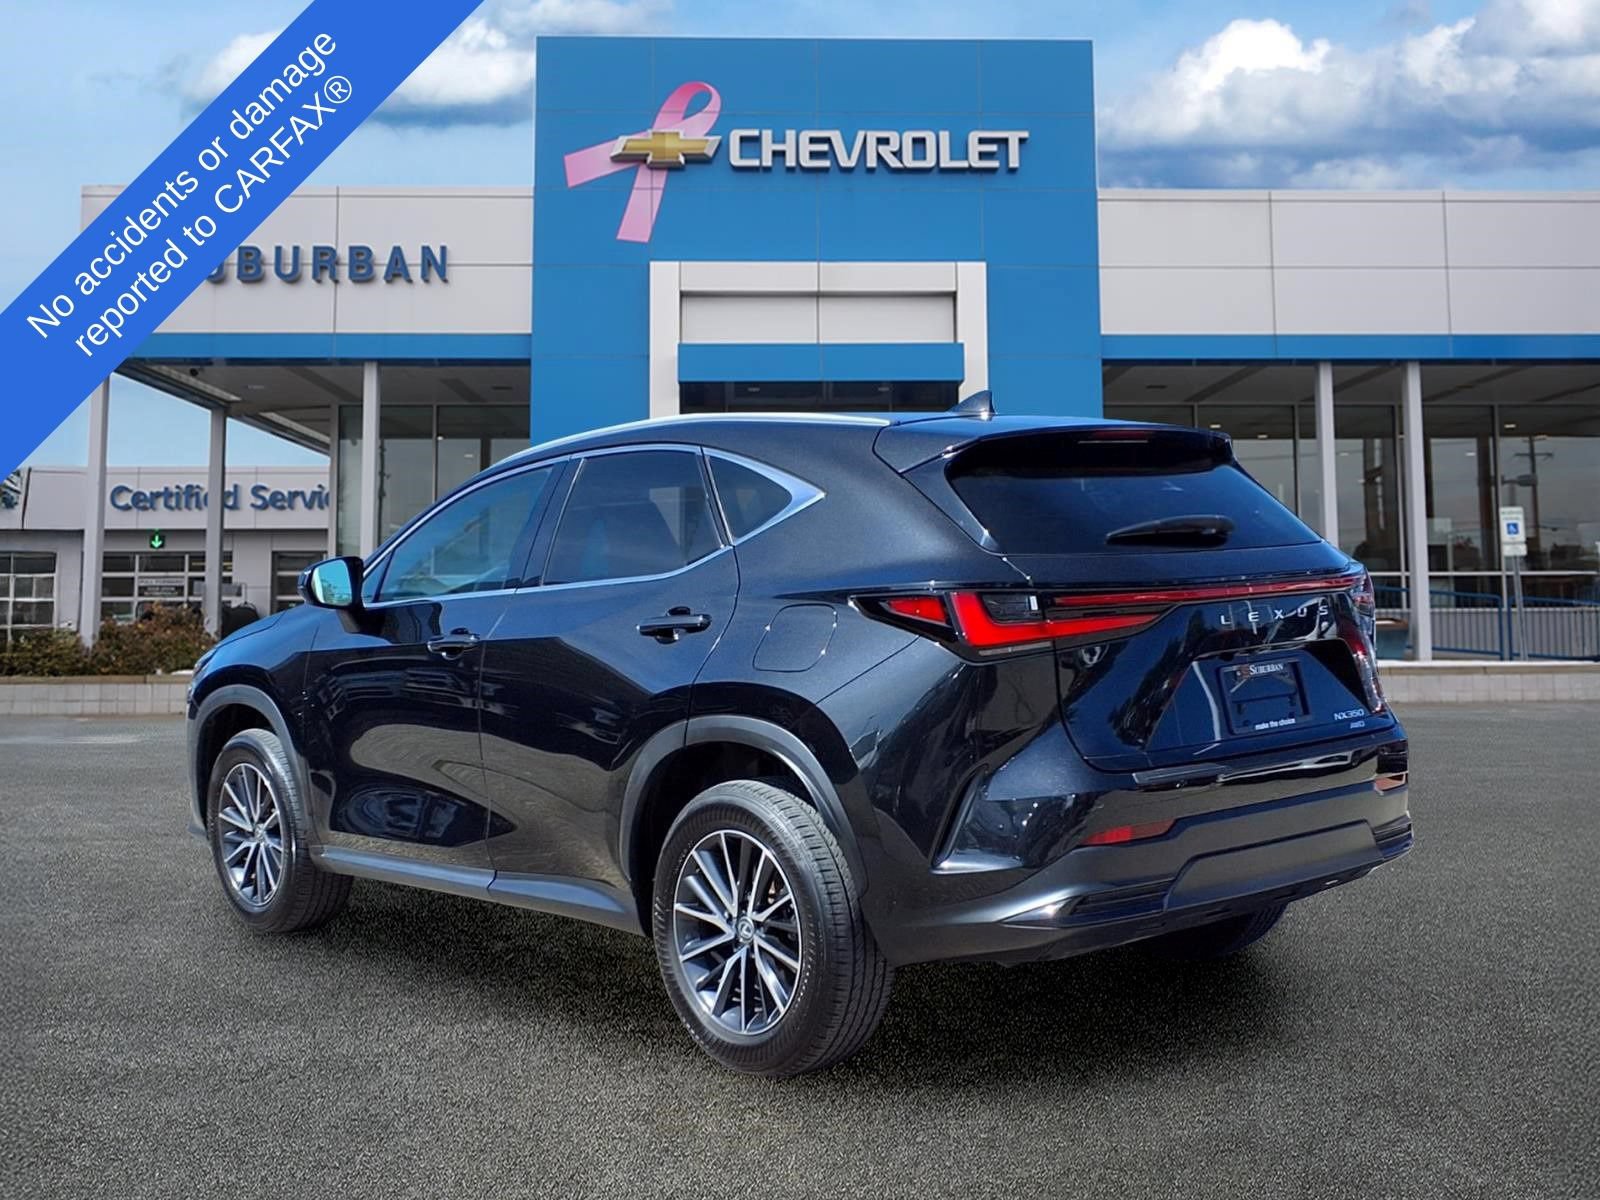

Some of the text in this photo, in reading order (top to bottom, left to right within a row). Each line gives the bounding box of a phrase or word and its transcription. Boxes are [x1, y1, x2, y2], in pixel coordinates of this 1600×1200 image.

[728, 129, 1029, 169] CHEVROLET
[250, 484, 330, 511] Servi
[1220, 605, 1329, 625] LEXUS
